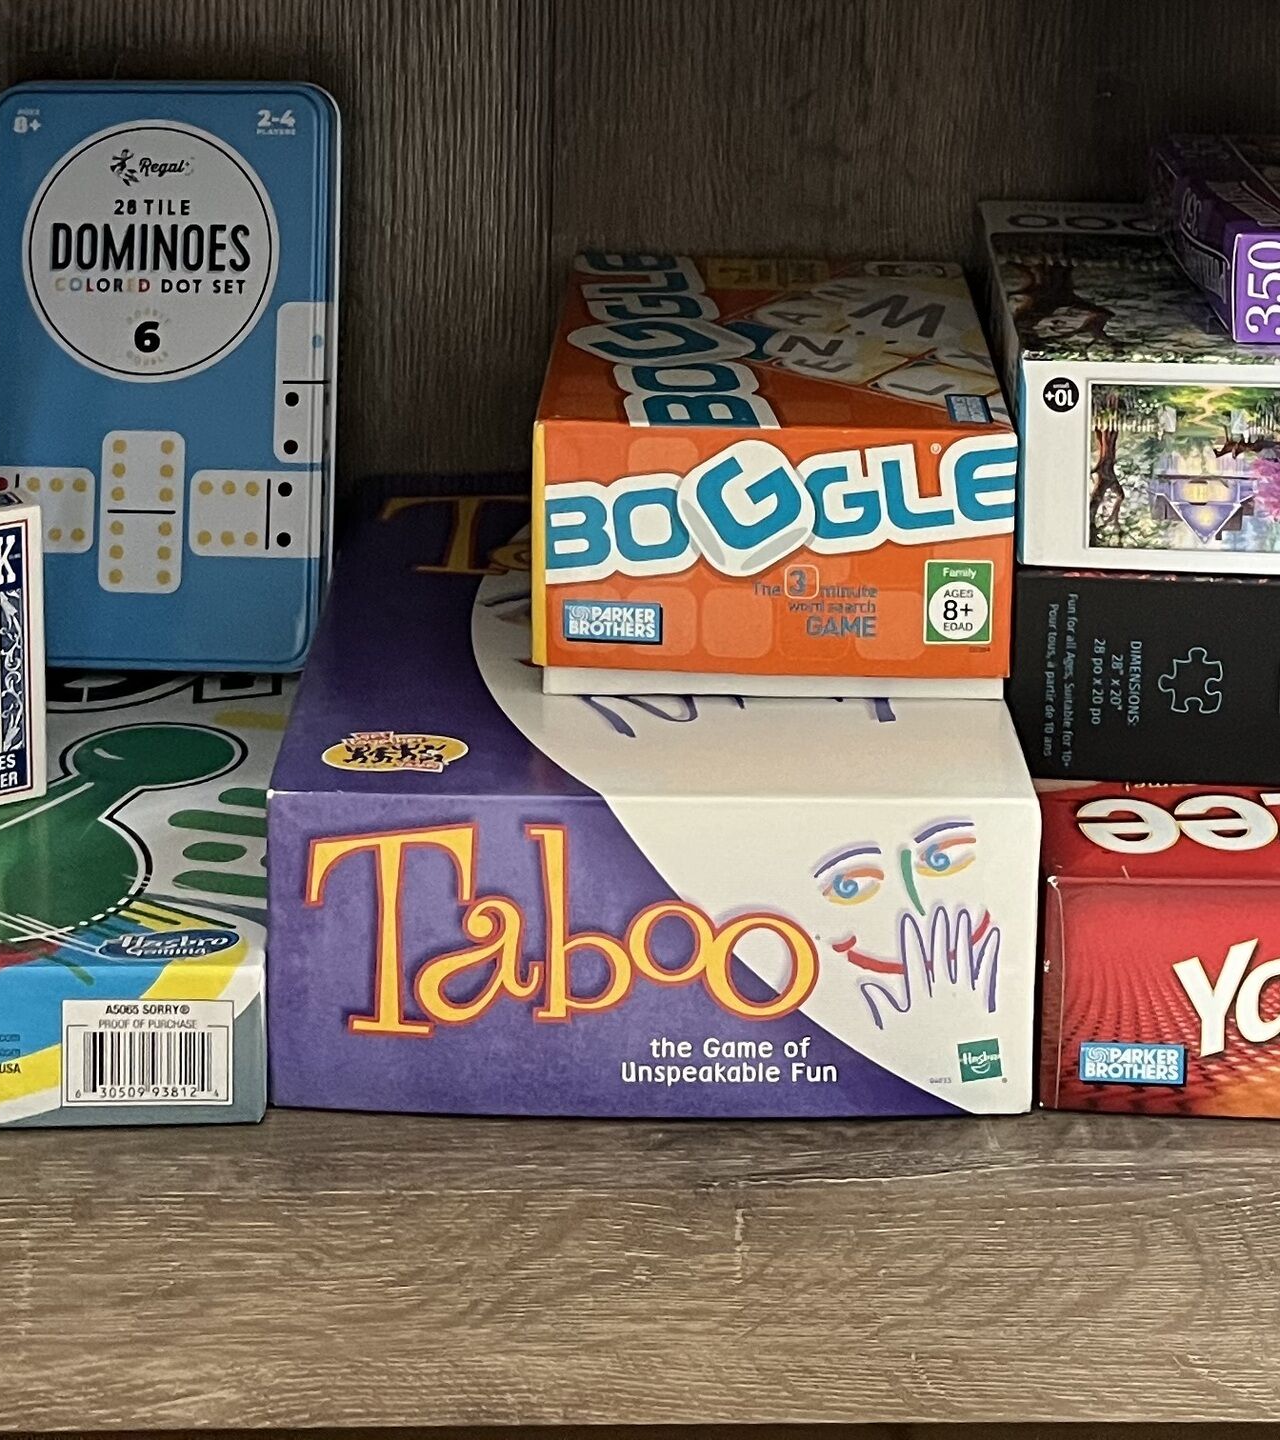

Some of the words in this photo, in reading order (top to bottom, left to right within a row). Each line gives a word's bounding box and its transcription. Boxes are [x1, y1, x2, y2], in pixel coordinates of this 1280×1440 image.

[257, 109, 296, 128] 2-4
[138, 157, 186, 178] Regal
[113, 199, 137, 216] 28
[143, 199, 191, 216] TILE
[51, 222, 251, 272] DOMINOES
[54, 277, 151, 293] COLORED
[160, 278, 201, 294] DOT
[212, 279, 246, 295] SET
[134, 321, 161, 353] 6
[1044, 388, 1075, 407] 10+
[545, 446, 1017, 570] BOGGLE
[942, 568, 977, 580] Family
[753, 582, 781, 596] The
[789, 569, 807, 597] 3
[819, 584, 878, 599] minute
[943, 589, 974, 599] AGES
[1067, 593, 1079, 614] Fun
[589, 605, 656, 623] PARKER
[788, 601, 825, 613] word
[828, 601, 876, 613] search
[943, 600, 974, 621] 8+
[1047, 603, 1060, 629] Pour
[569, 620, 656, 639] BROTHERS
[806, 615, 877, 638] GAME
[1065, 616, 1078, 633] for
[1045, 631, 1059, 658] tous,
[1065, 634, 1077, 650] all
[1093, 638, 1106, 654] 28
[1063, 651, 1077, 680] Ages,
[1090, 658, 1103, 675] po
[1044, 670, 1057, 702] partir
[1093, 677, 1102, 686] x
[1127, 640, 1143, 727] DIMENSIONS:
[1062, 682, 1076, 728] Suitable
[1092, 688, 1104, 704] 20
[1044, 704, 1056, 719] de
[1088, 707, 1102, 725] po
[1044, 721, 1055, 734] 10
[1043, 736, 1054, 757] ans
[1062, 730, 1074, 746] for
[1062, 749, 1073, 767] 10+
[307, 822, 819, 1036] Taboo
[99, 1019, 131, 1029] PROOF
[132, 1019, 145, 1029] OF
[148, 1019, 198, 1029] PURCHASE
[650, 1037, 693, 1058] the
[702, 1037, 776, 1058] Game
[784, 1035, 811, 1058] of
[1109, 1048, 1179, 1065] PARKER
[620, 1061, 785, 1086] Unspeakable
[793, 1061, 838, 1084] Fun
[1084, 1063, 1179, 1081] BROTHERS
